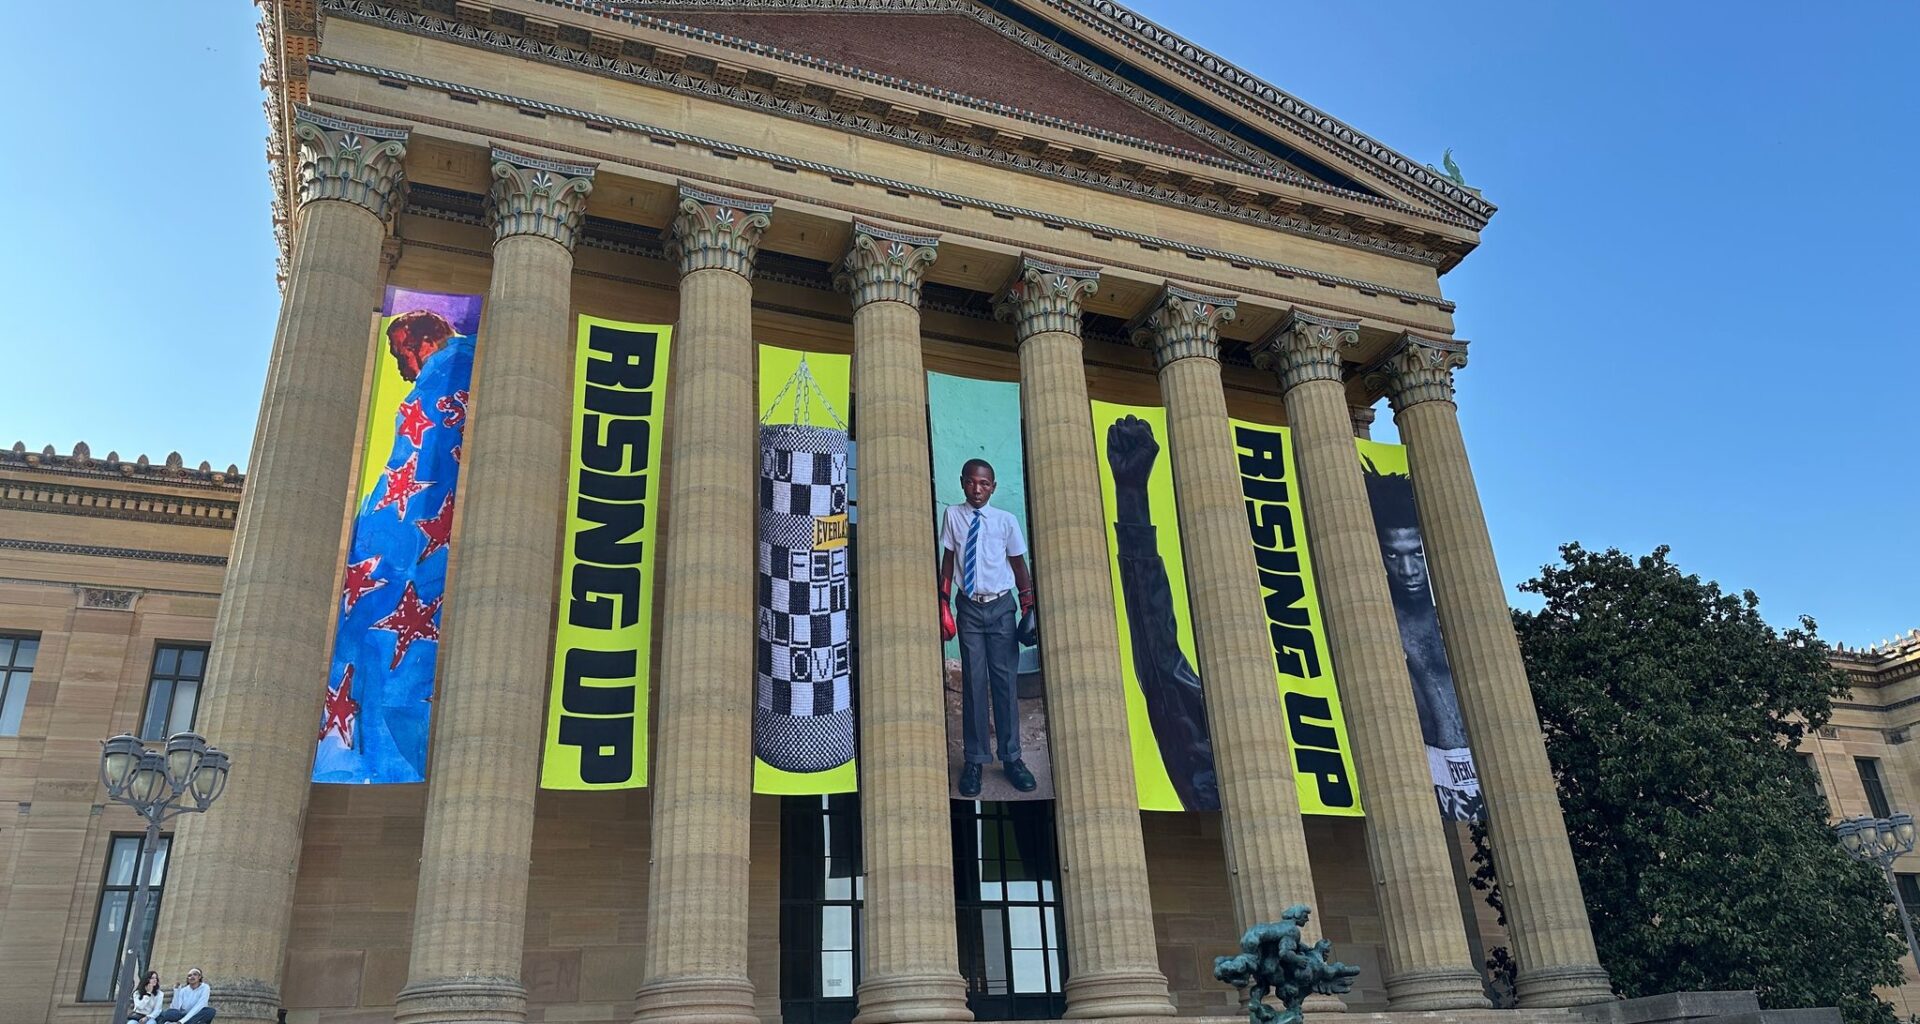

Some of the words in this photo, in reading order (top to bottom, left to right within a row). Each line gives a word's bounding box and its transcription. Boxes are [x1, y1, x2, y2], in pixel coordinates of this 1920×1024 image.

[569, 324, 658, 630] RISING
[760, 608, 809, 646] ALL
[812, 581, 845, 612] IT
[1235, 426, 1322, 679] RISING
[1284, 691, 1354, 808] UP
[558, 647, 636, 784] UP
